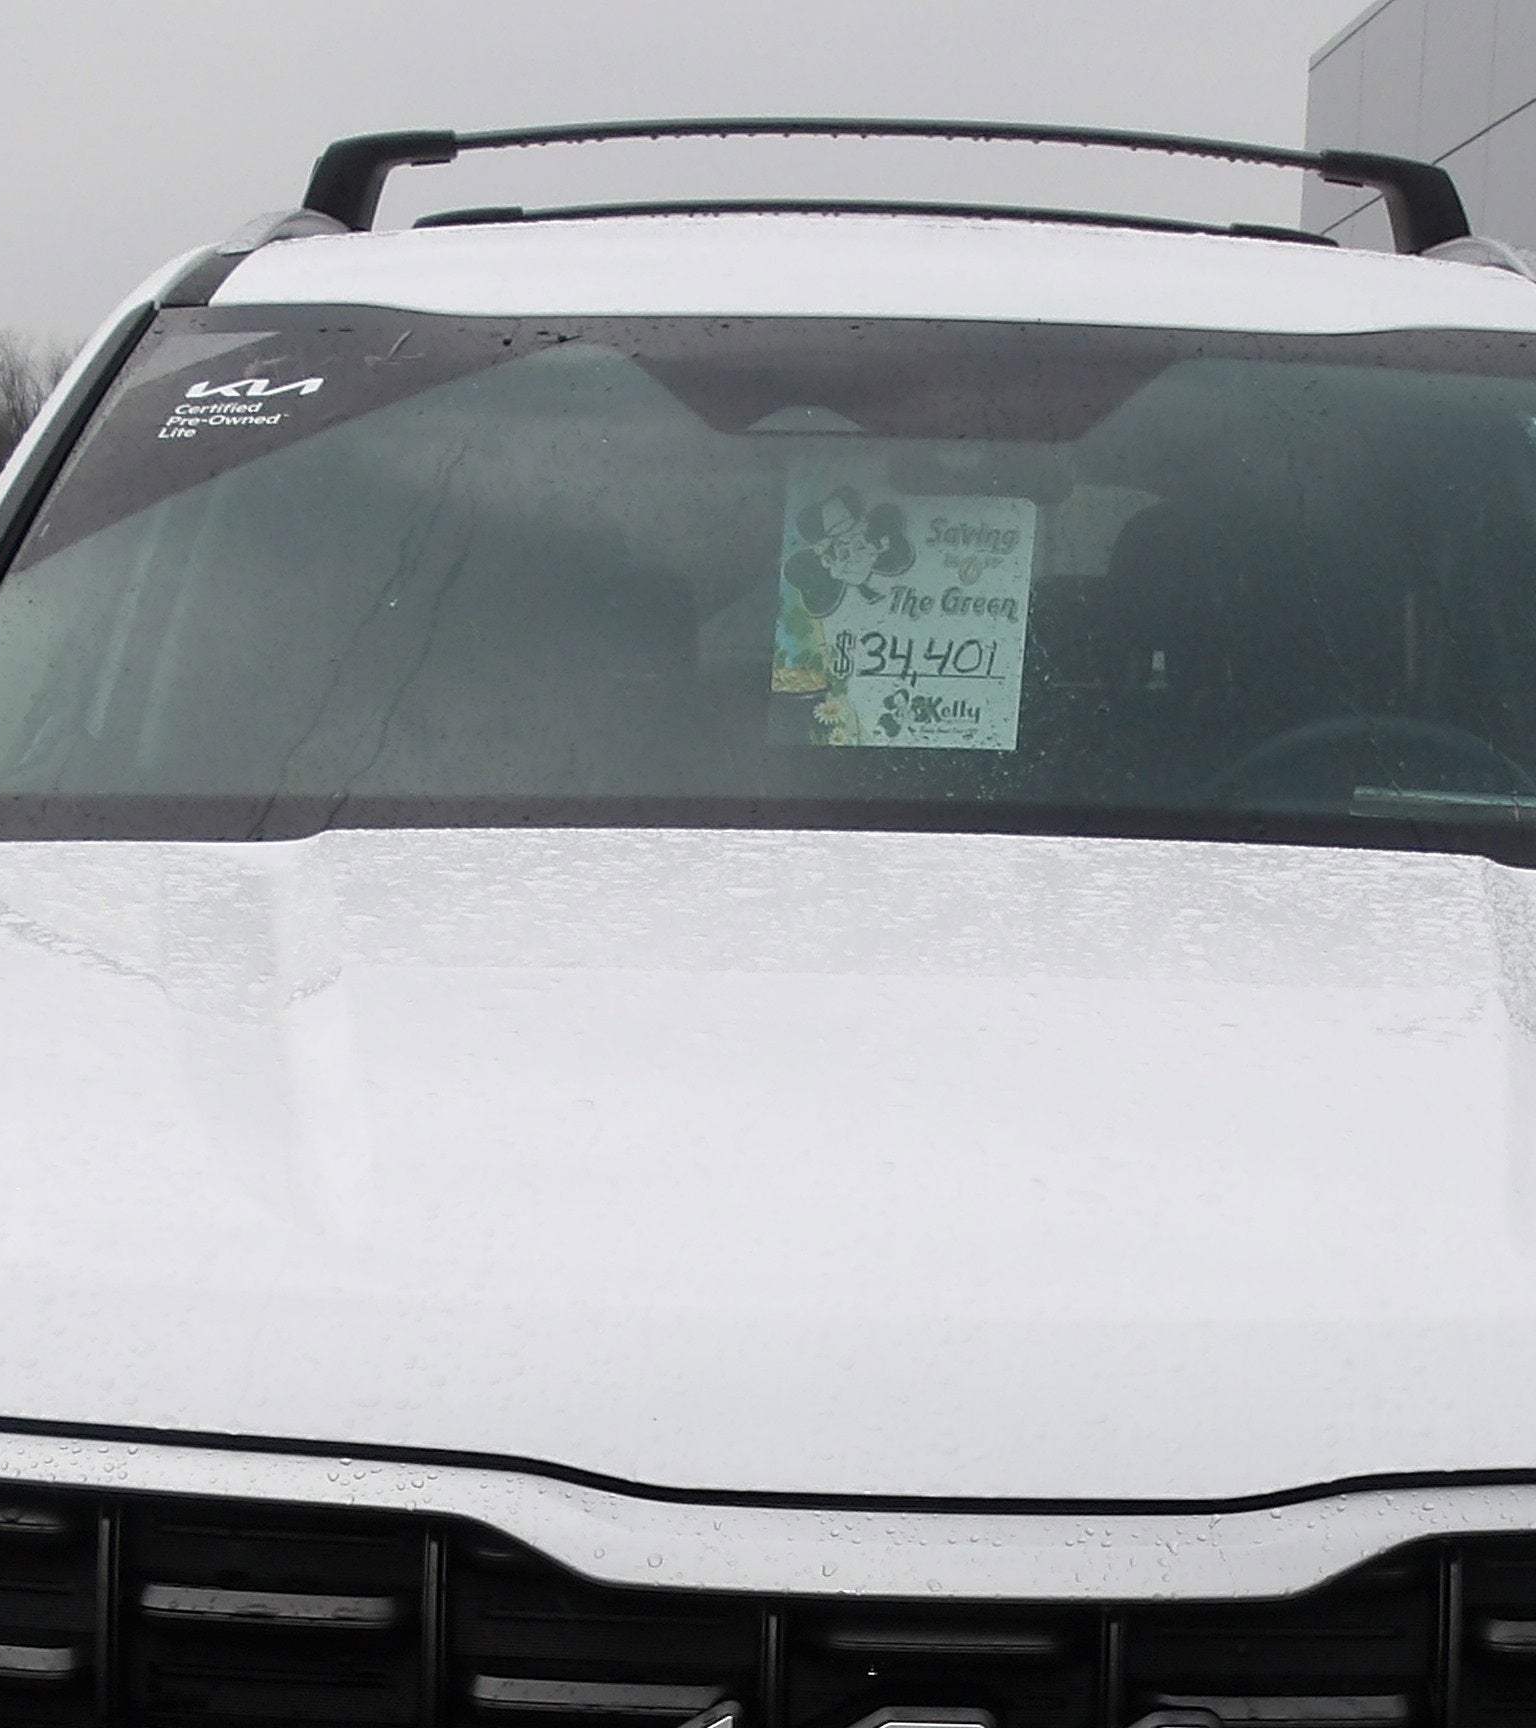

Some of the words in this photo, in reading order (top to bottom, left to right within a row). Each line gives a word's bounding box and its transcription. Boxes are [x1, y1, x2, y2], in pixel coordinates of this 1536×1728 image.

[184, 376, 325, 399] KIA
[174, 401, 263, 414] Certified
[157, 427, 197, 439] Lite
[926, 518, 1021, 554] Saving
[888, 585, 934, 617] The
[939, 587, 1020, 622] Green
